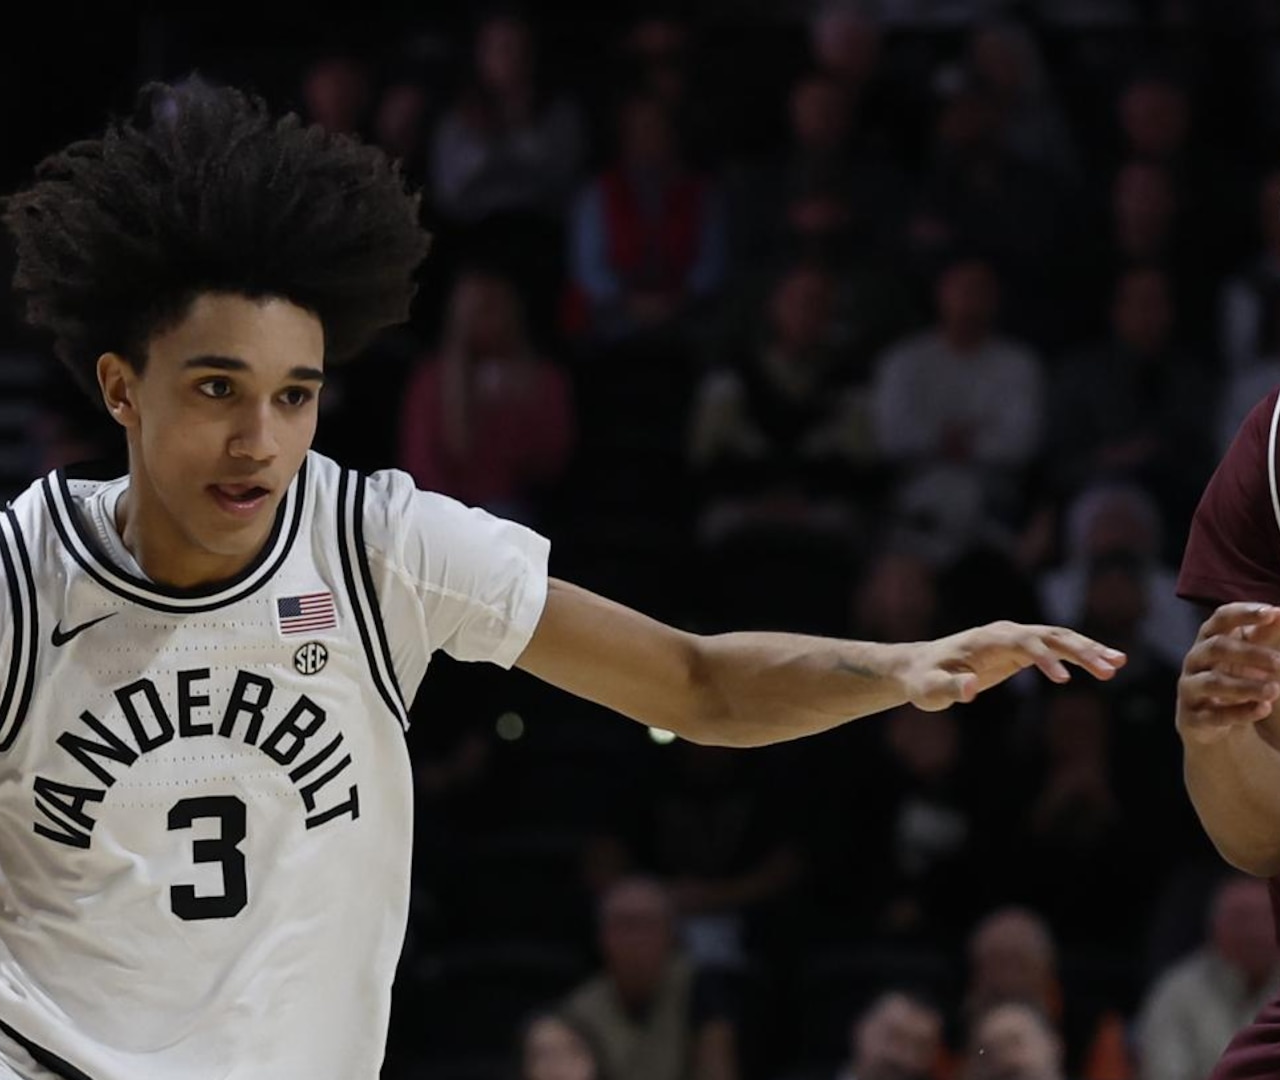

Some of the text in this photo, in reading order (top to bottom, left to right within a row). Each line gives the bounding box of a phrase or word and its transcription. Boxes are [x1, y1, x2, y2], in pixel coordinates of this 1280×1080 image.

[295, 642, 327, 675] SEC
[33, 668, 360, 849] VANDERBILT
[167, 795, 248, 921] 3
